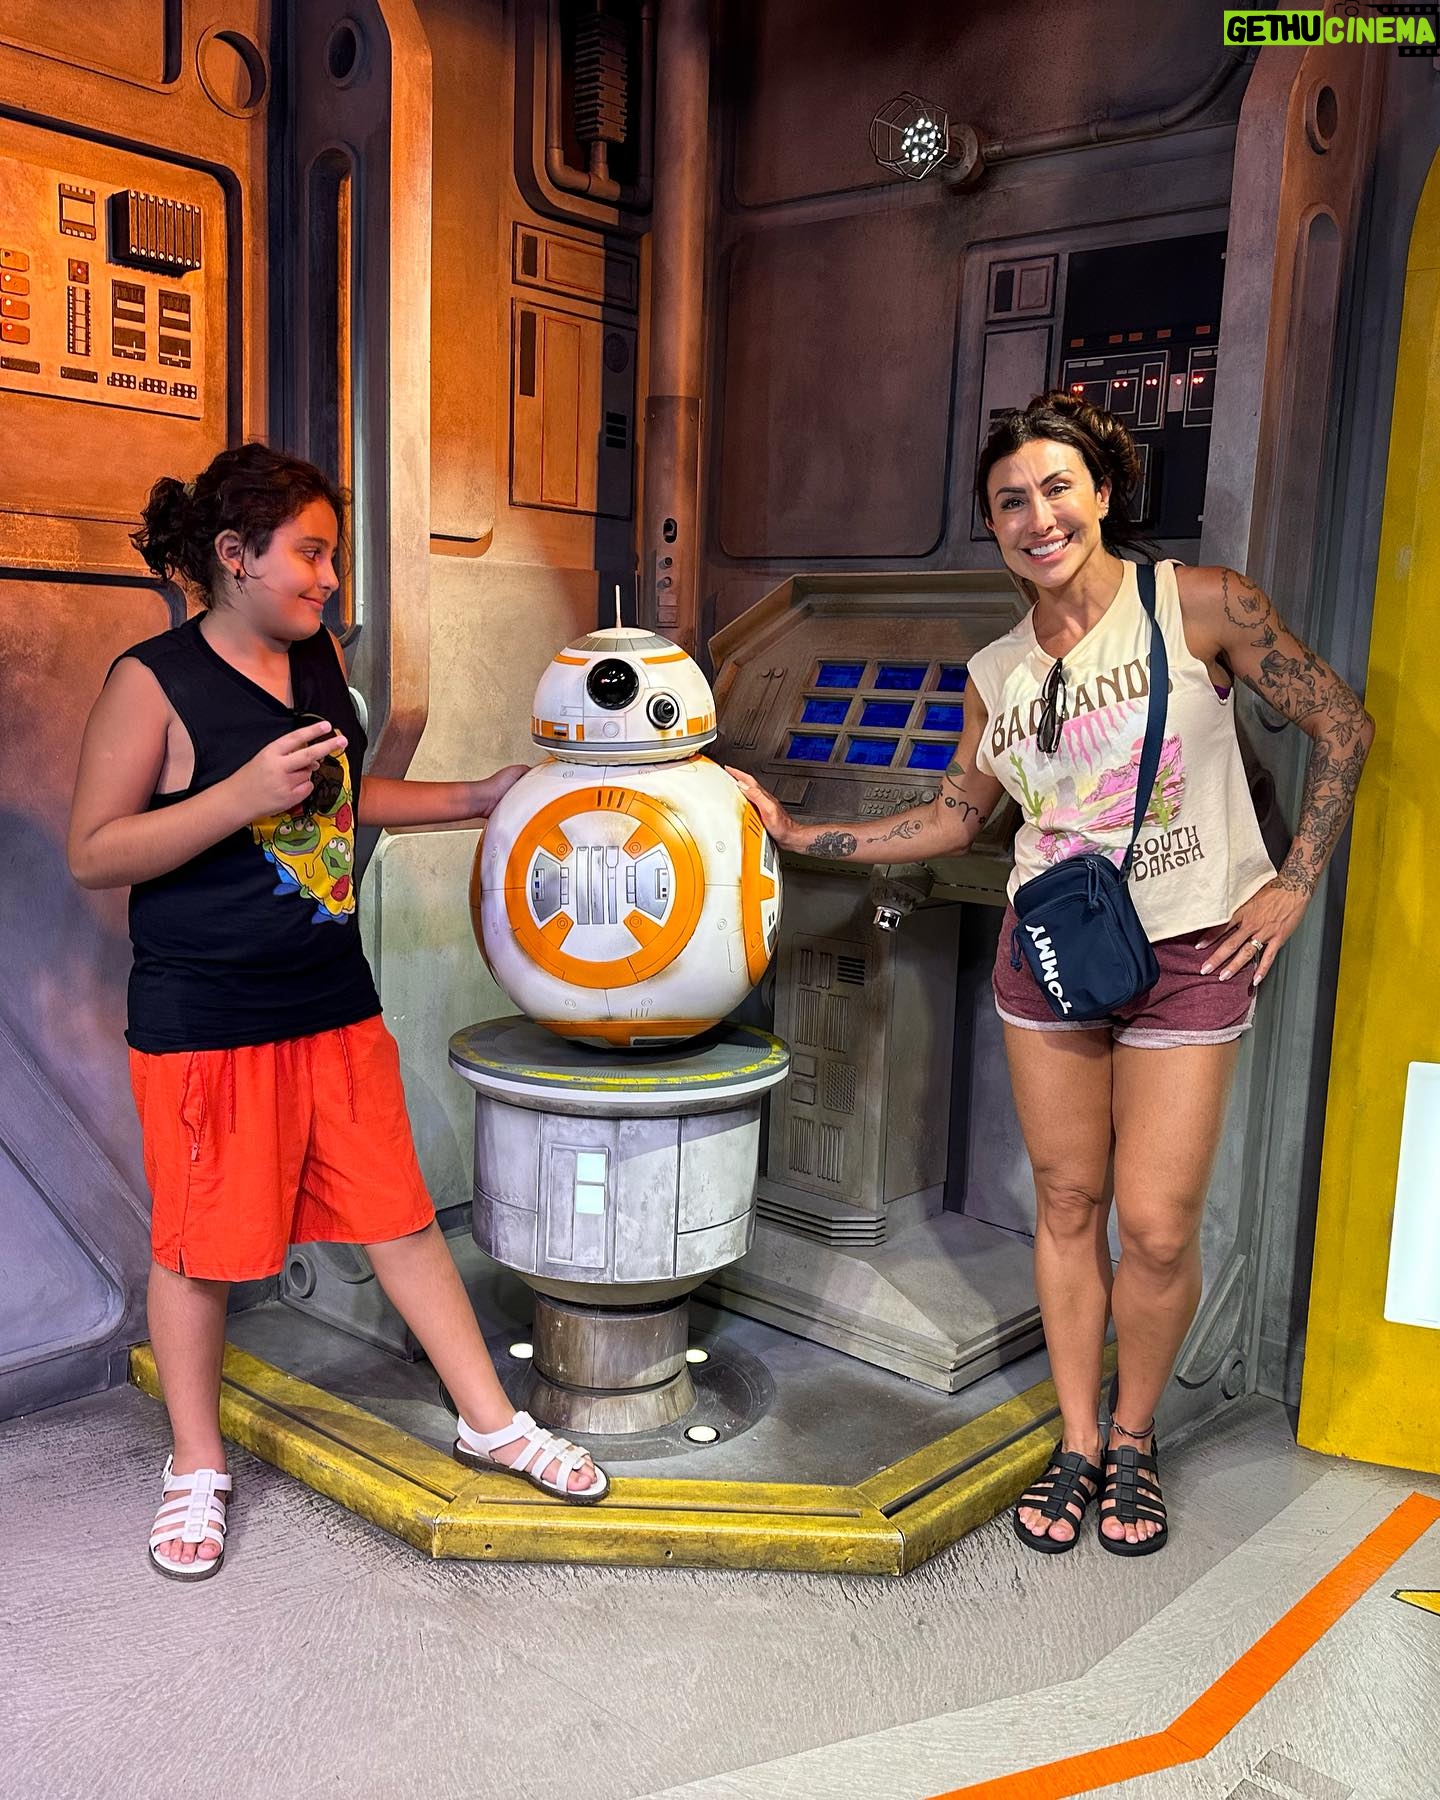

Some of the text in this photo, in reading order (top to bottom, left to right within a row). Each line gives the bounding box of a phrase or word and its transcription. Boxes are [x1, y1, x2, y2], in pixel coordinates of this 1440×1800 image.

[991, 652, 1174, 759] BADAND
[1131, 825, 1200, 863] SOUTH
[1133, 842, 1205, 882] DAKOTA
[1025, 924, 1073, 1015] TOMMY
